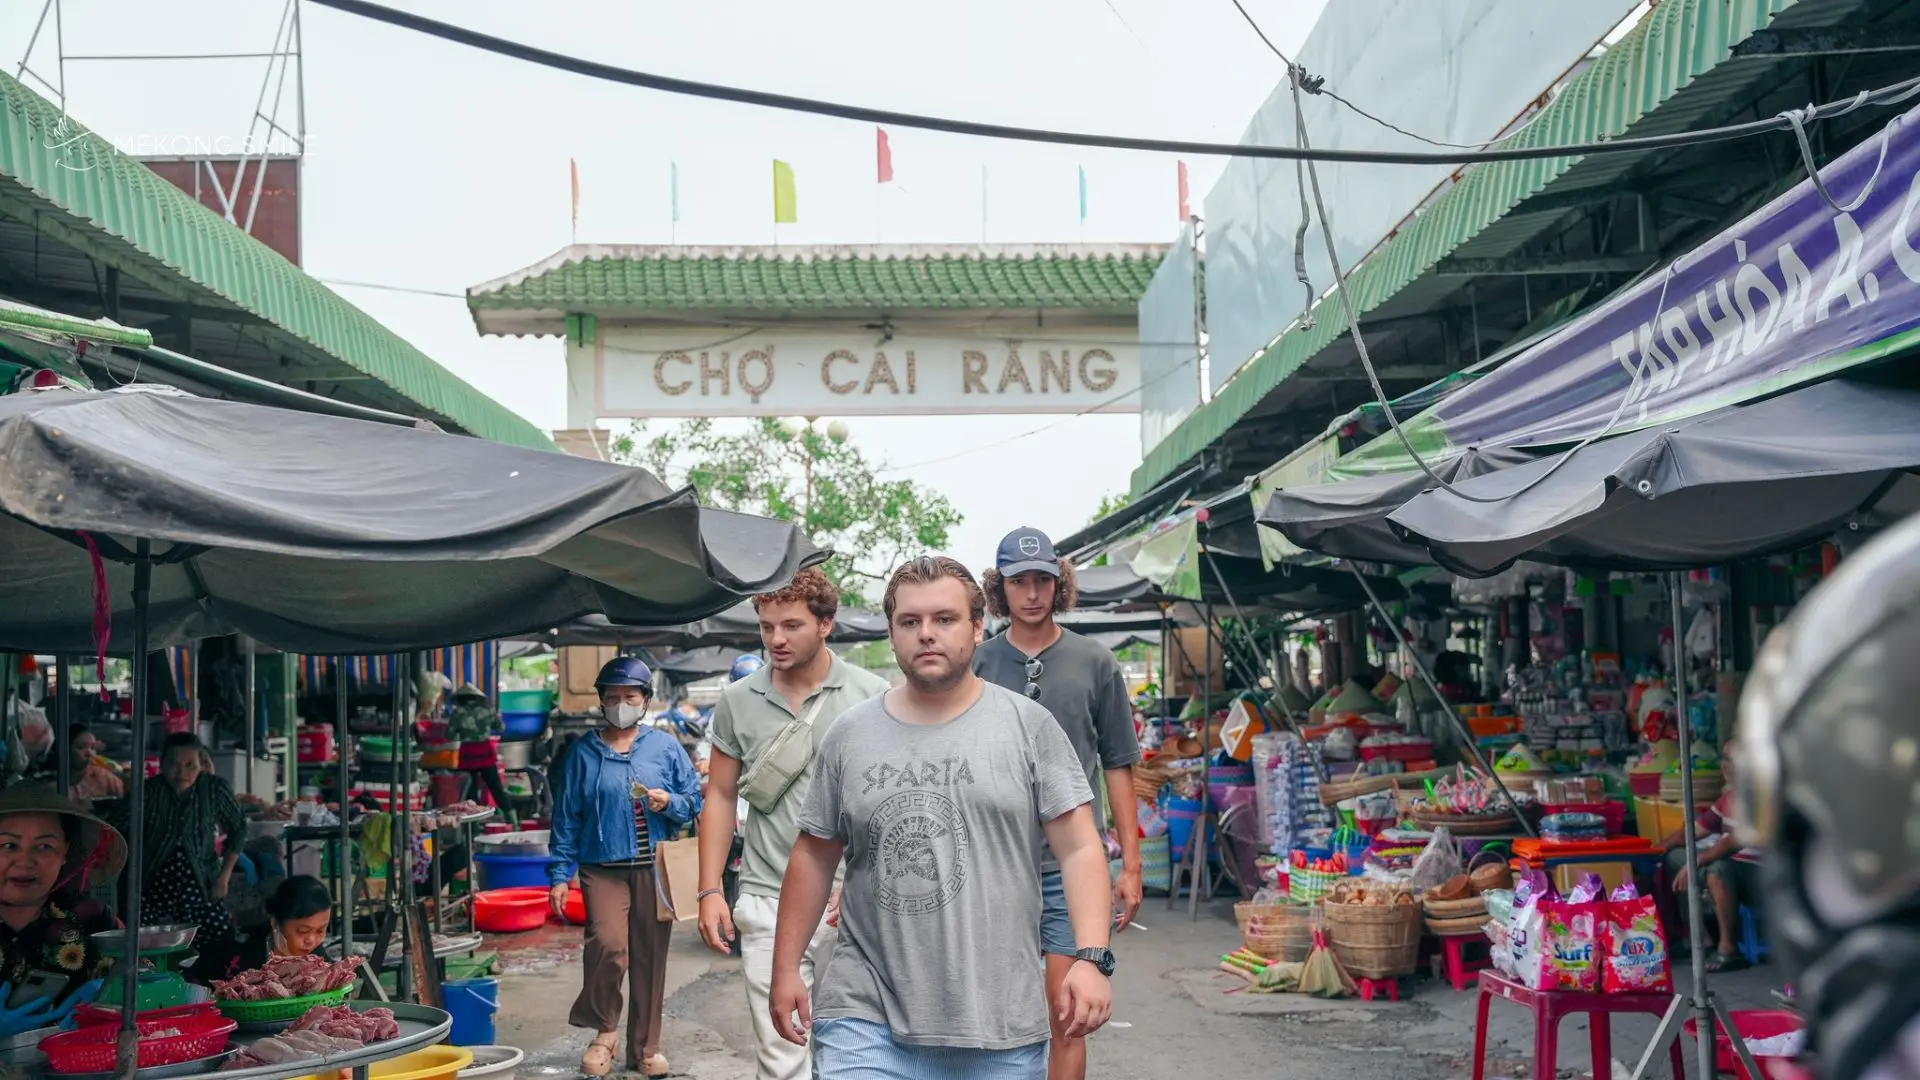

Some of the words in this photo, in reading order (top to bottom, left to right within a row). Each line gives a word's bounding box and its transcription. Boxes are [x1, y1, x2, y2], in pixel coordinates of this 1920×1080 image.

[1611, 306, 1701, 423] TẠP
[1696, 239, 1811, 374] HÓA
[653, 344, 774, 404] CHỢ
[862, 756, 975, 795] SPARTA
[1554, 943, 1592, 961] Surf
